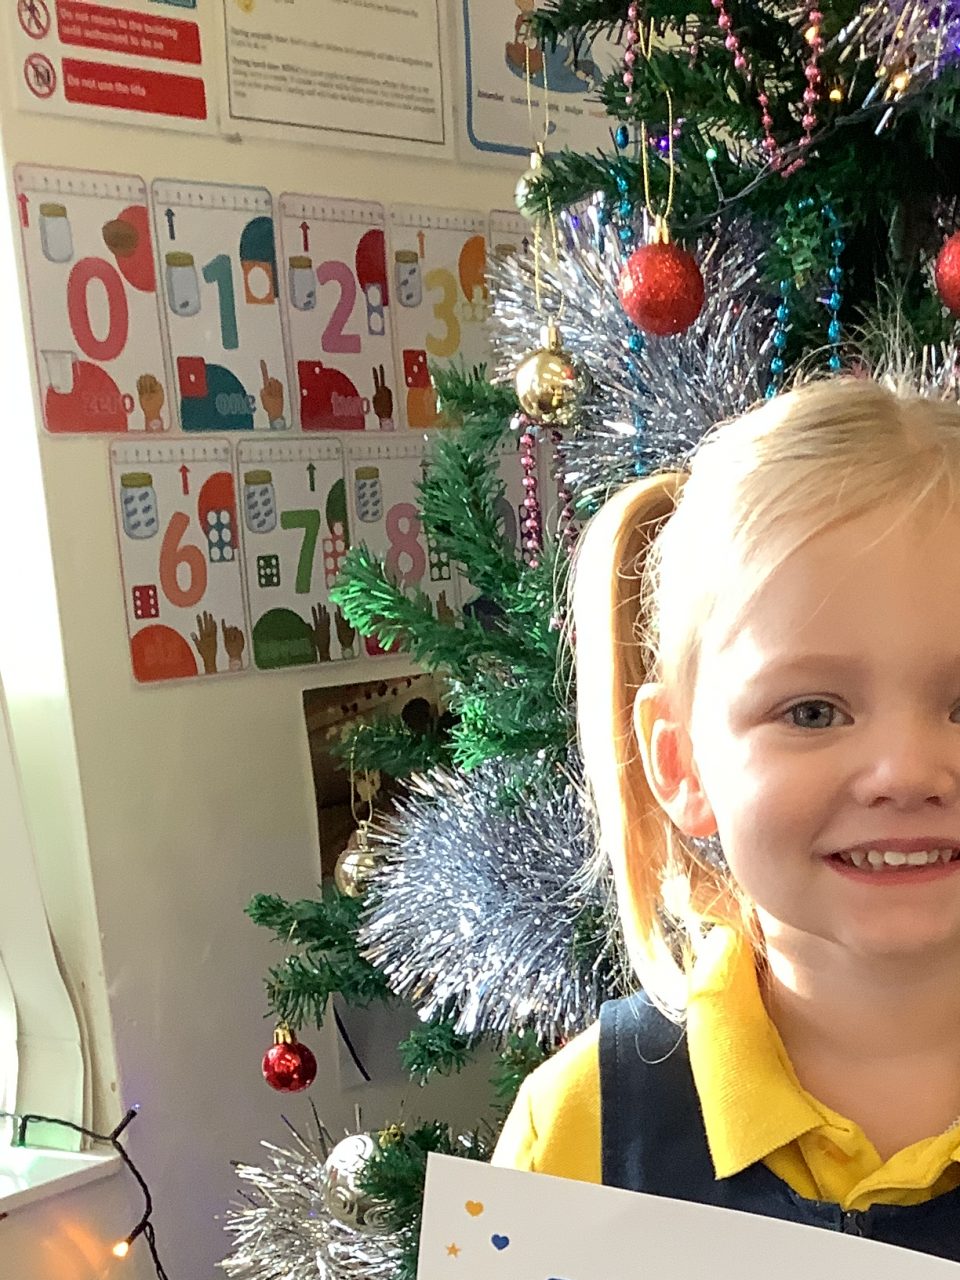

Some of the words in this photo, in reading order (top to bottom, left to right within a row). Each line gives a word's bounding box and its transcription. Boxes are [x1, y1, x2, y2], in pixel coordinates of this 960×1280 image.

[67, 257, 129, 361] 0
[202, 254, 239, 350] 1
[316, 260, 361, 354] 2
[424, 268, 461, 357] 3
[159, 512, 207, 607] 6
[280, 509, 320, 594] 7
[386, 502, 426, 588] 8
